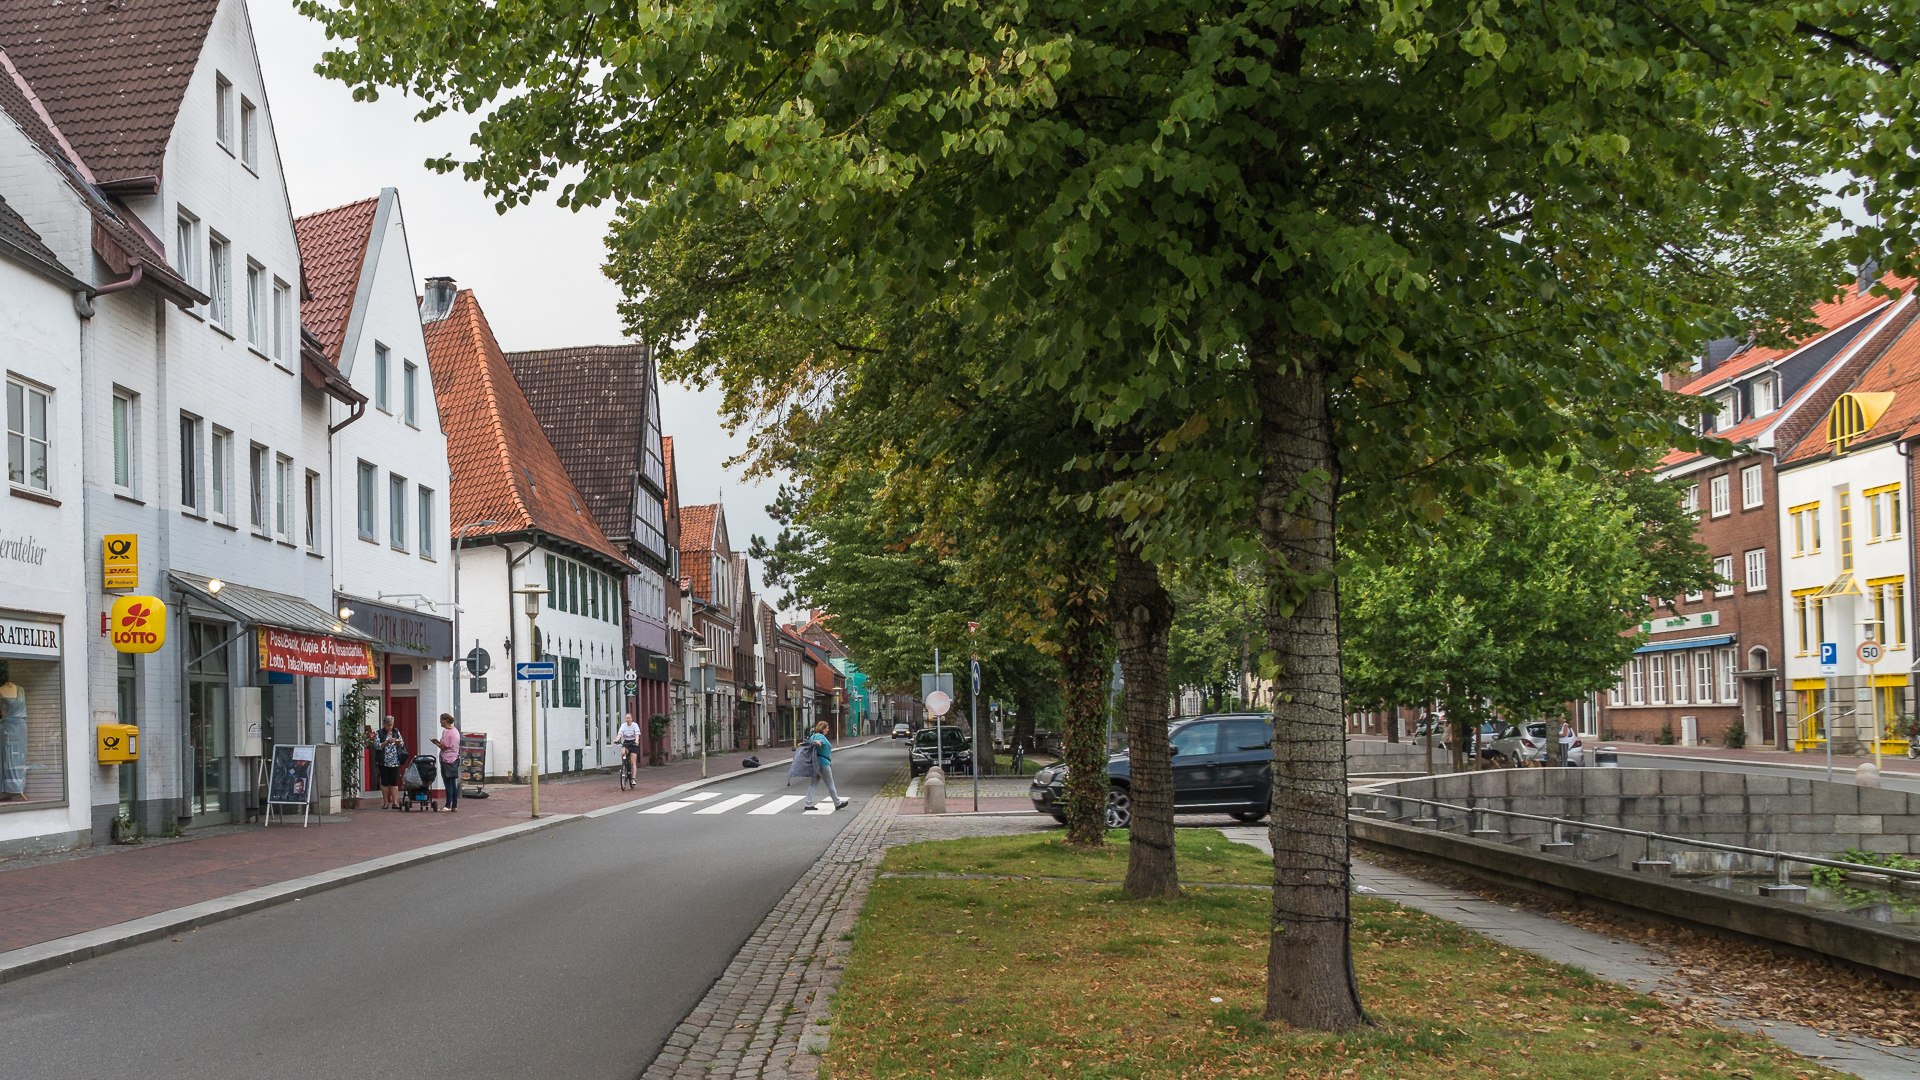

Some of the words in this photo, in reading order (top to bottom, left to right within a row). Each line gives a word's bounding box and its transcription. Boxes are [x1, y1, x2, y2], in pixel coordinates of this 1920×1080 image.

[0, 529, 47, 566] eratelier
[114, 631, 157, 644] LOTTO
[301, 637, 319, 656] Kopie
[320, 640, 328, 654] &
[1822, 645, 1832, 662] P
[1862, 646, 1878, 658] 50
[269, 652, 286, 671] Lotto,
[286, 655, 322, 675] Tabakwaren,
